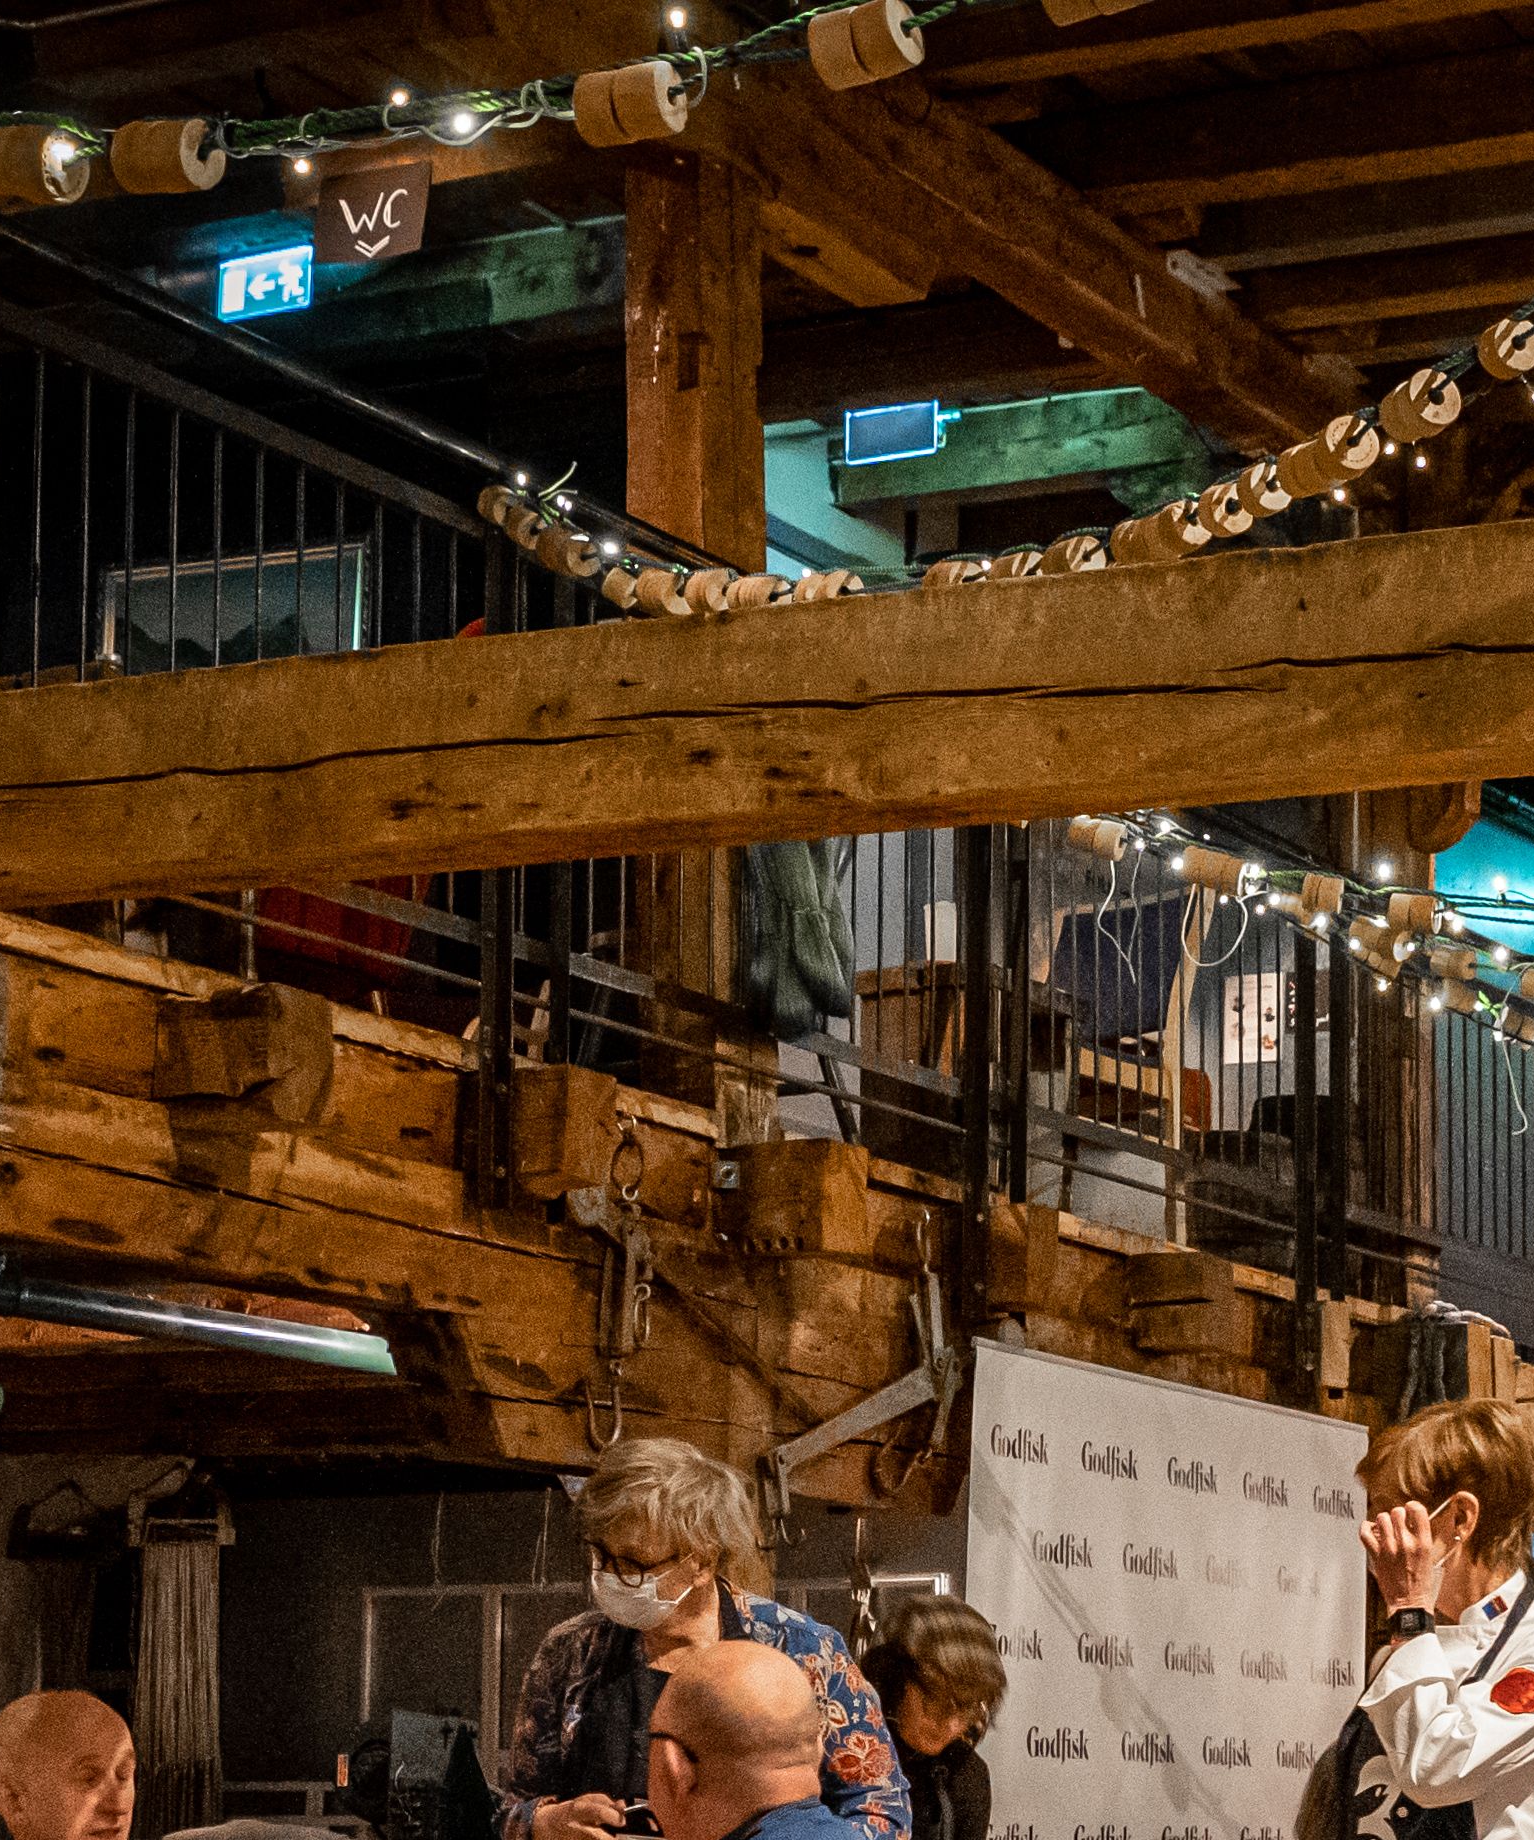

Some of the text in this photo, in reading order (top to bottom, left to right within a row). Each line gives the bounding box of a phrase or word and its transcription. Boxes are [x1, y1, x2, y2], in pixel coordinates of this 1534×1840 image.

[338, 188, 409, 234] WC
[990, 1423, 1049, 1466] Godfisk
[1081, 1440, 1139, 1481] Godfisk
[1167, 1456, 1218, 1495] Godfisk
[1243, 1471, 1289, 1508] Godfisk
[1313, 1484, 1355, 1520] Godfisk
[1032, 1529, 1093, 1570] Godfisk
[1122, 1542, 1179, 1581] Godfisk
[990, 1623, 1043, 1662] odfisk
[1077, 1631, 1134, 1673] Godfisk
[1165, 1640, 1215, 1678] Godfisk
[1026, 1725, 1090, 1765] Godfisk
[1121, 1730, 1176, 1768] Godfisk
[1202, 1735, 1252, 1770] Godfisk
